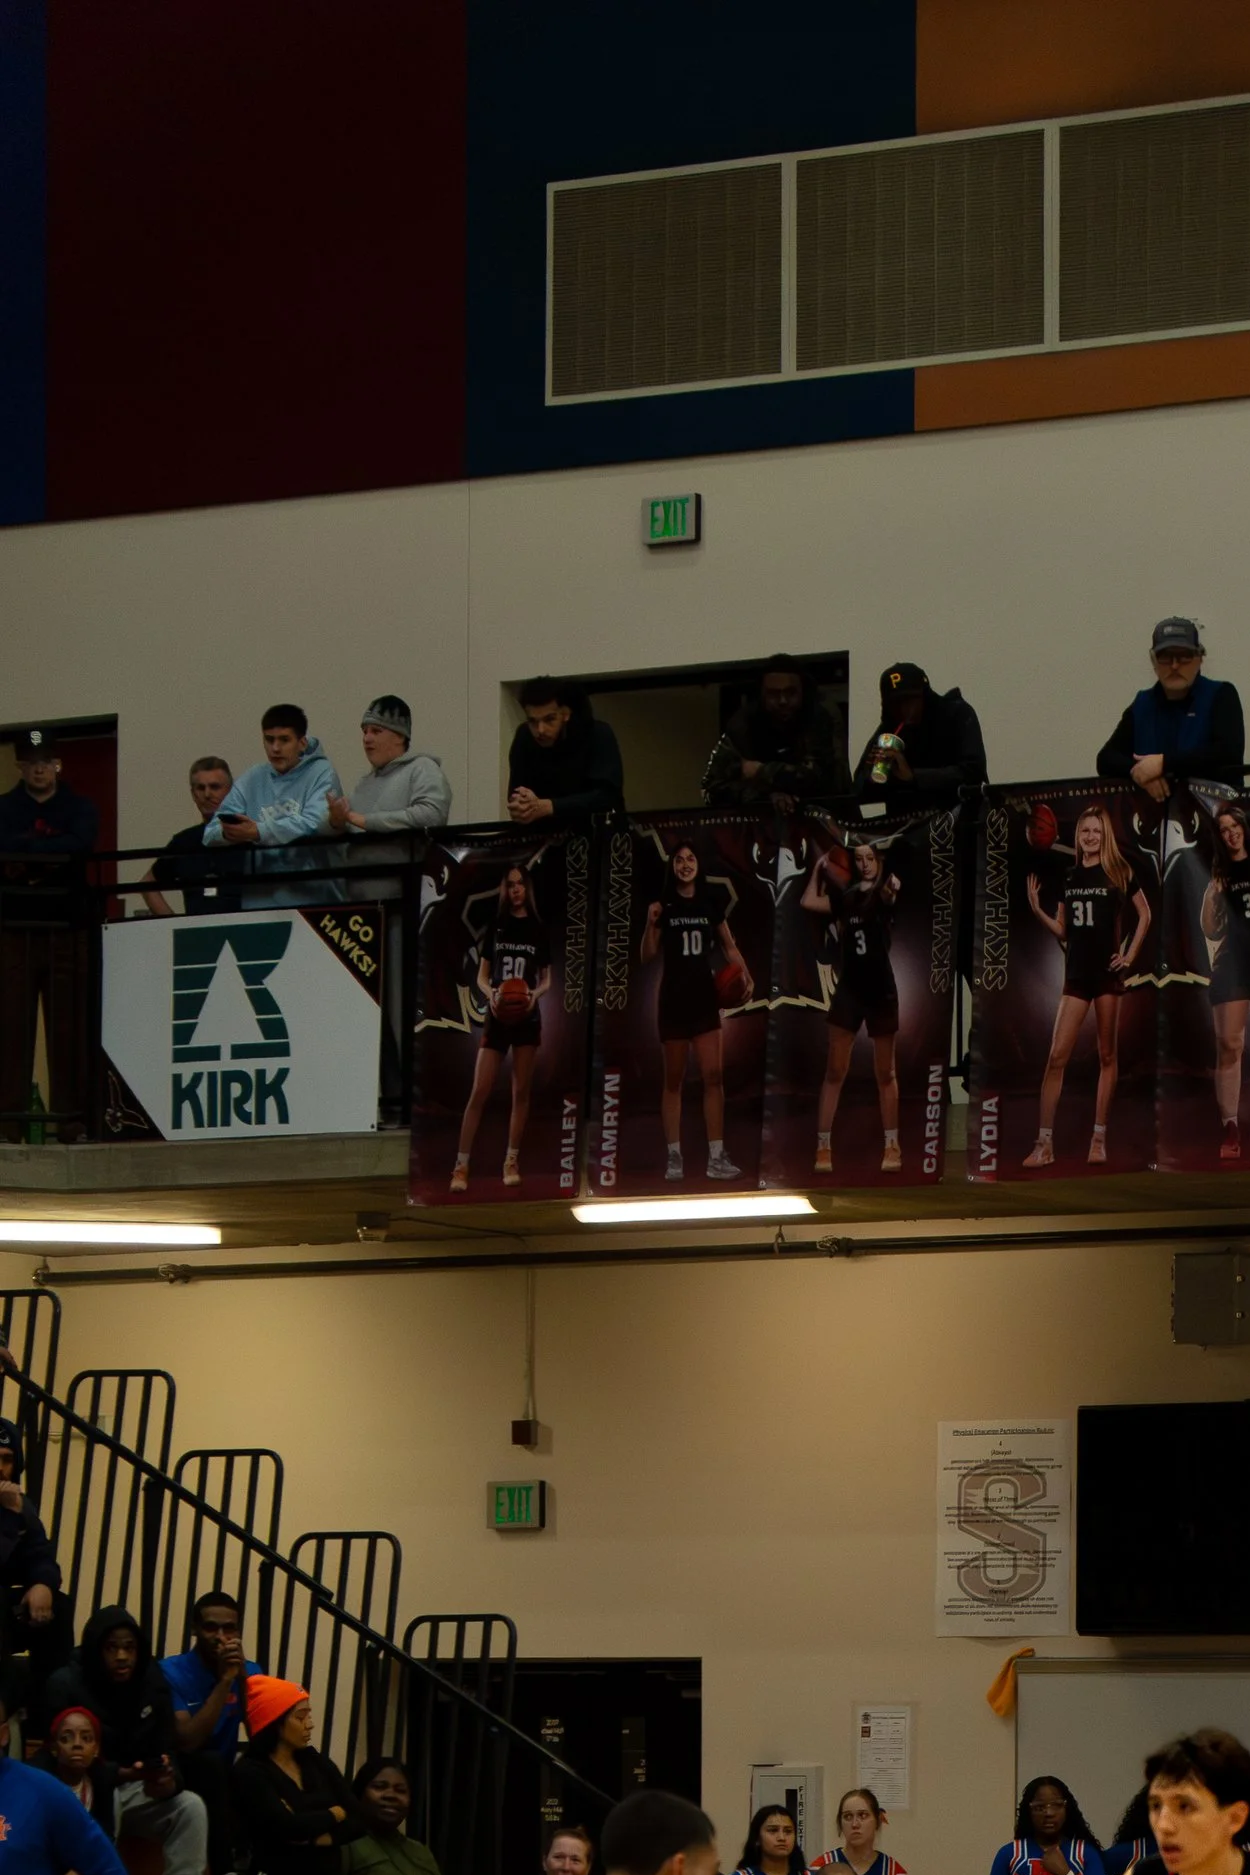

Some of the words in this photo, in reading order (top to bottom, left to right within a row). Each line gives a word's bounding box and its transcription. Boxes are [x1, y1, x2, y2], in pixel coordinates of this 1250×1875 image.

[651, 498, 689, 539] EXIT
[890, 672, 901, 688] P
[348, 915, 375, 943] GO
[564, 835, 590, 1014] SKYHAWKS
[604, 831, 634, 1012] SKYHAWKS
[929, 810, 956, 995] SKYHAWKS
[982, 806, 1009, 991] SKYHAWKS
[1072, 901, 1094, 927] 31
[319, 913, 378, 978] HAWKS!
[502, 956, 527, 980] 20
[682, 931, 703, 956] 10
[855, 930, 867, 955] 3
[172, 1067, 290, 1130] KIRK
[600, 1073, 621, 1187] CAMRYN
[923, 1064, 944, 1174] CARSON
[560, 1099, 578, 1189] BAILEY
[979, 1096, 1000, 1172] LYDIA
[495, 1486, 533, 1524] EXIT
